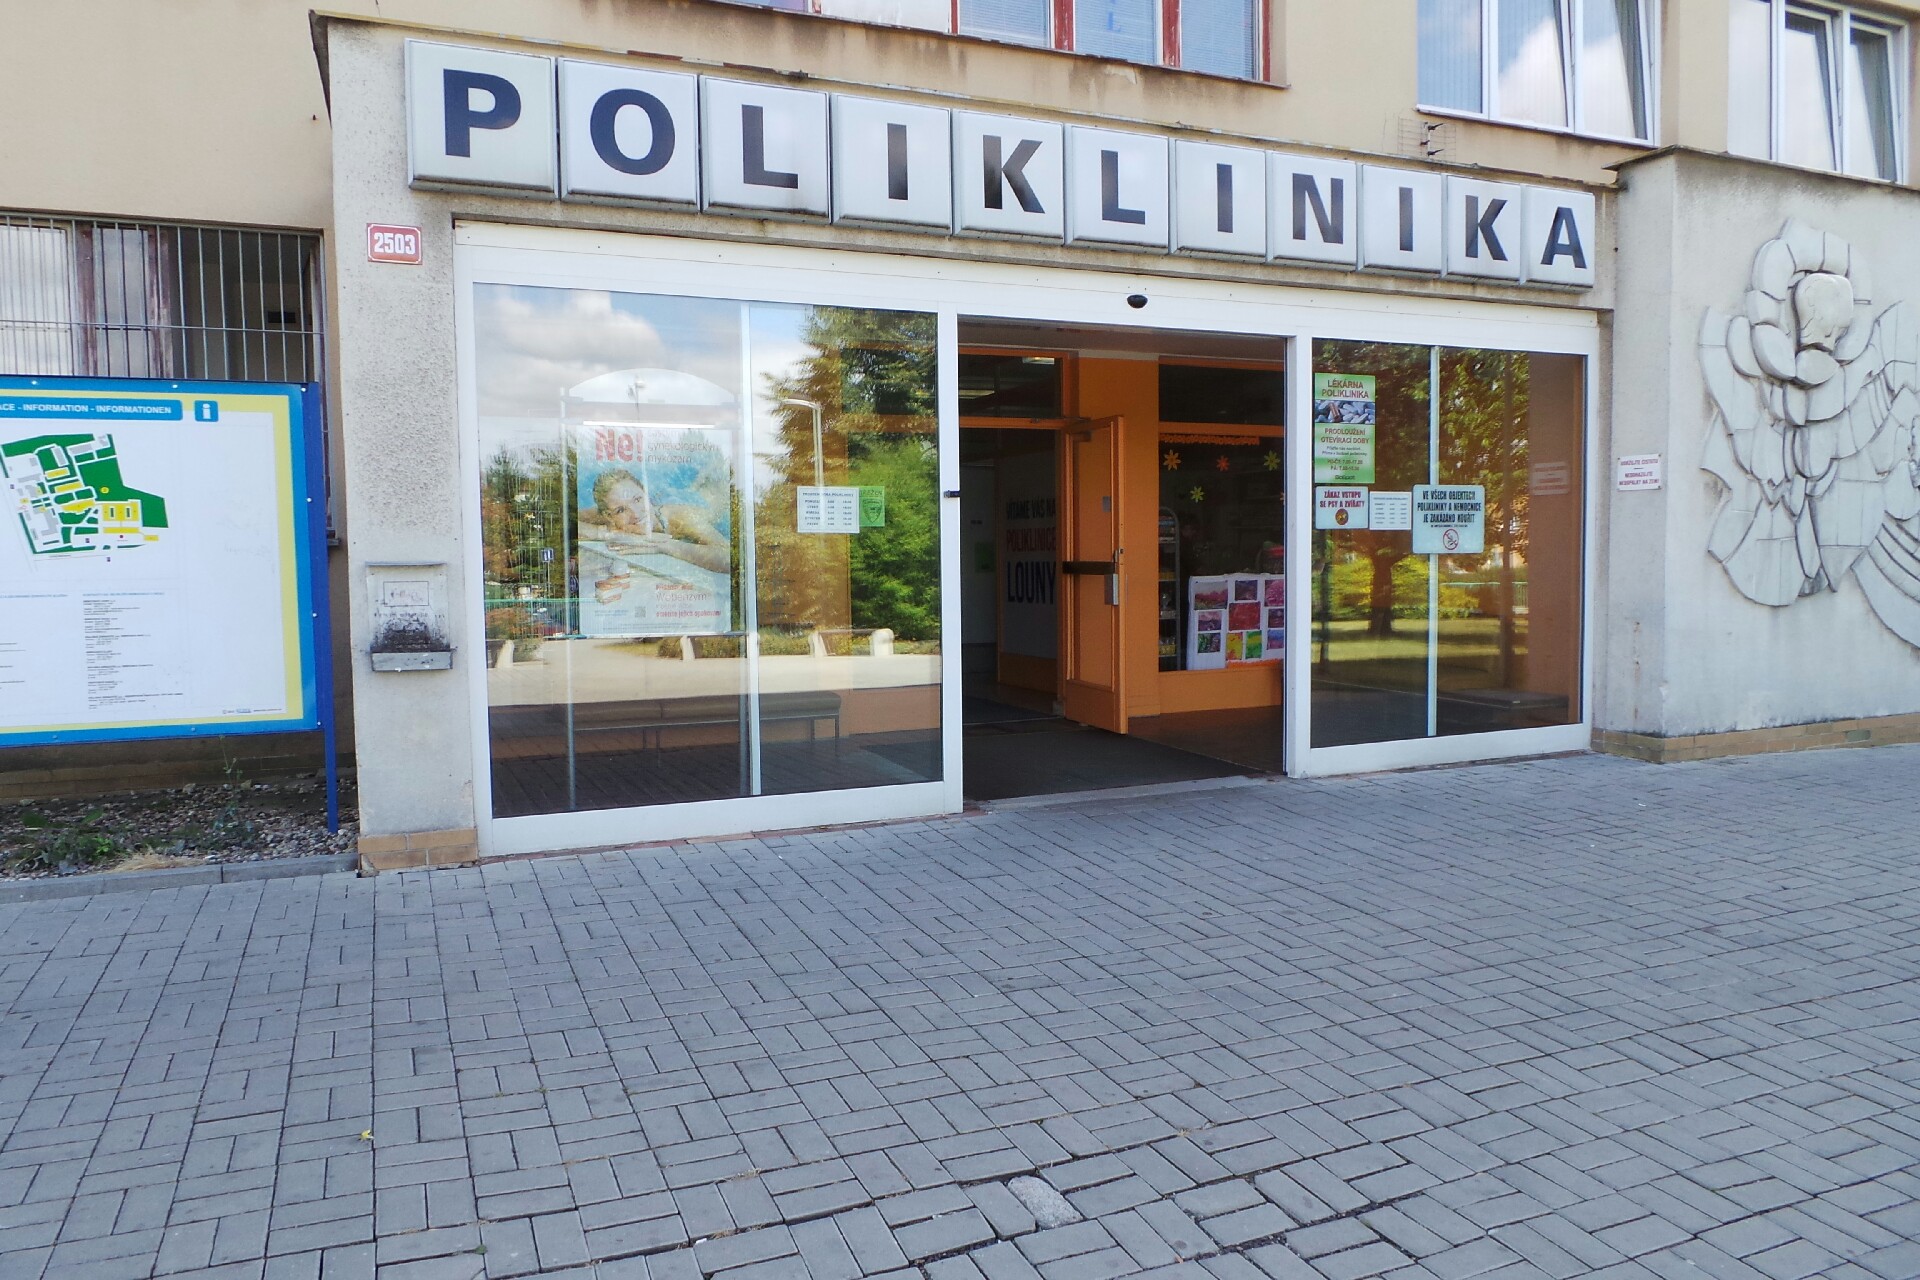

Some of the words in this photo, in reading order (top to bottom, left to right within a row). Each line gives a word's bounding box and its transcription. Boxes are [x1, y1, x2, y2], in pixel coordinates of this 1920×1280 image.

[443, 69, 1586, 268] POLIKLINIKA
[373, 232, 416, 254] 2503
[1327, 378, 1364, 389] LÉKÁRNA
[1321, 388, 1369, 398] POLIKLINIKA
[23, 404, 89, 413] INFORMATION
[96, 406, 172, 414] INFORMATIONEN
[595, 428, 644, 463] Ne!
[1321, 436, 1352, 444] OTEVÍRACÍ
[1324, 490, 1341, 499] ZÁKAZ
[1342, 491, 1361, 499] VSTUPU
[1423, 491, 1429, 500] VE
[1431, 489, 1448, 500] VŠECH
[1449, 491, 1476, 500] OBJEKTECH
[1345, 499, 1366, 508] ZVÍŘATY
[1417, 502, 1447, 511] POLIKLINIKY
[1449, 503, 1453, 511] A
[1454, 503, 1481, 511] NEMOCNICE
[1423, 513, 1429, 523] JE
[1430, 512, 1456, 523] ZAKÁZÁNO
[1458, 512, 1476, 523] KOUŘIT
[1007, 561, 1057, 605] LOUNY
